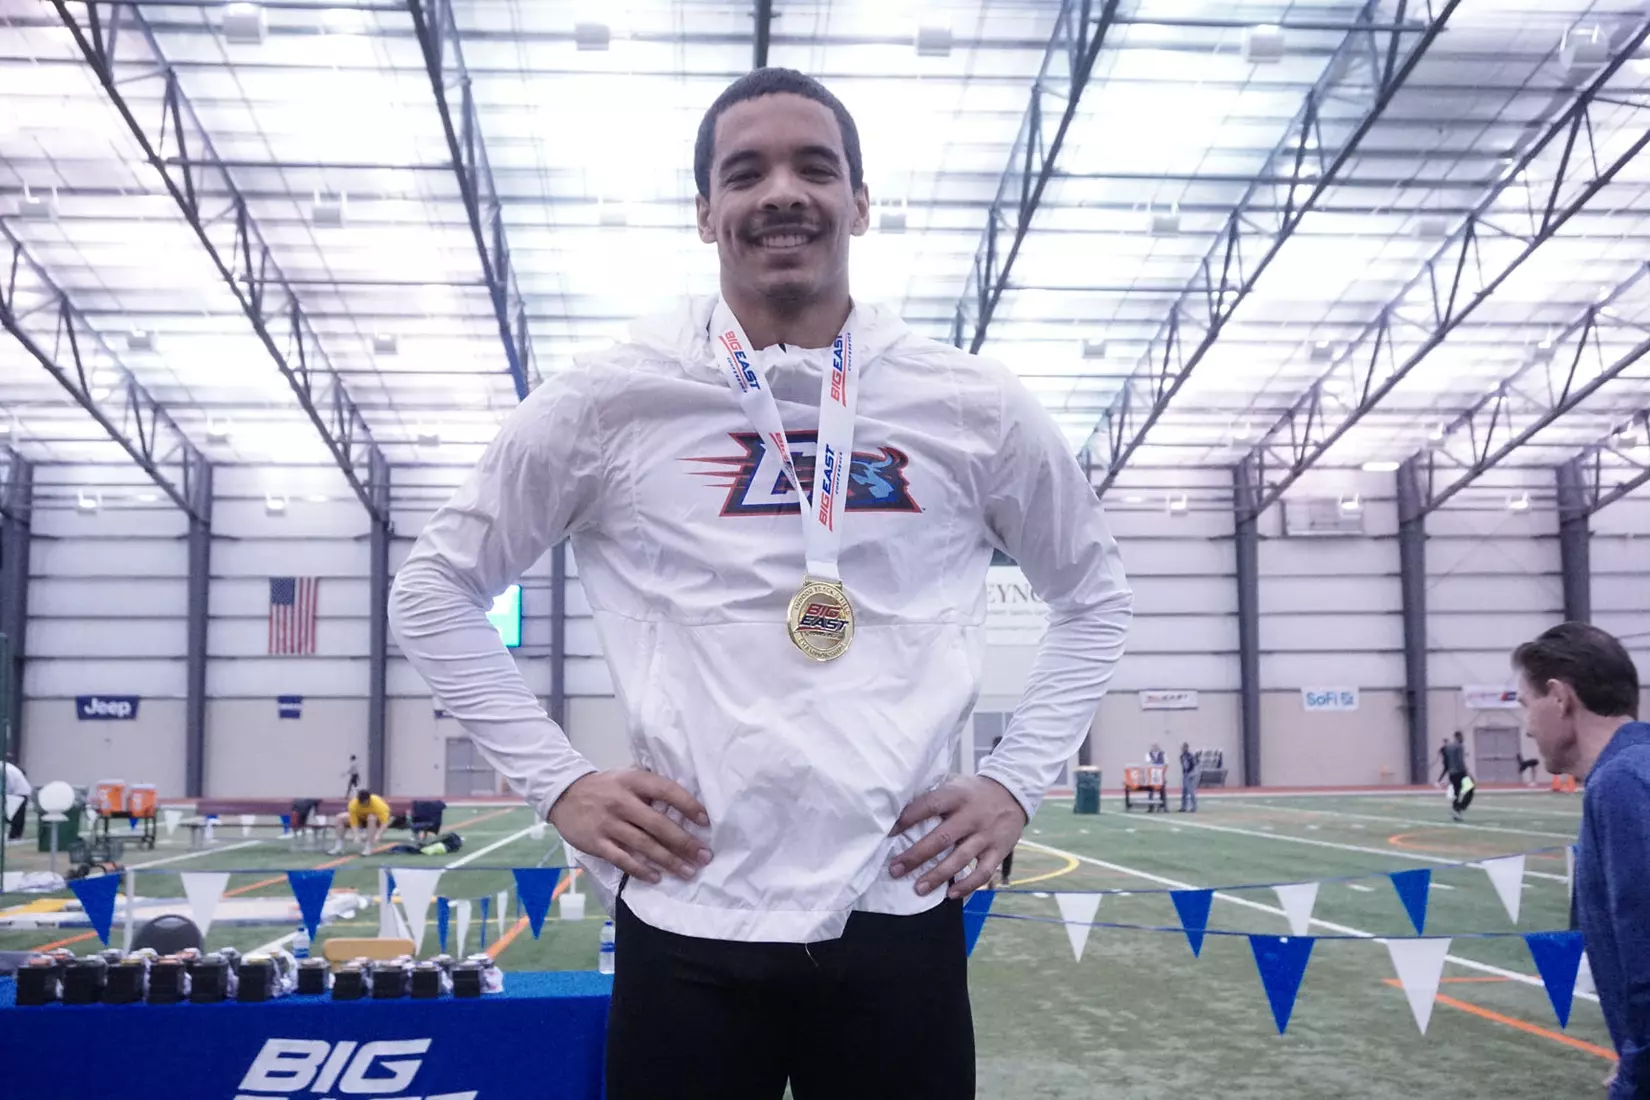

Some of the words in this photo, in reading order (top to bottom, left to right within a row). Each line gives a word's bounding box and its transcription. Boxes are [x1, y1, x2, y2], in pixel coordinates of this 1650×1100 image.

[725, 330, 743, 351] BIG
[733, 350, 761, 390] EAST
[831, 368, 842, 402] BIG
[822, 443, 835, 495] EAST
[818, 491, 830, 526] BIG
[799, 614, 849, 632] EAST
[806, 603, 843, 619] BIG
[84, 697, 132, 718] Jeep
[1306, 691, 1338, 707] SoFi
[238, 1038, 432, 1094] BIG
